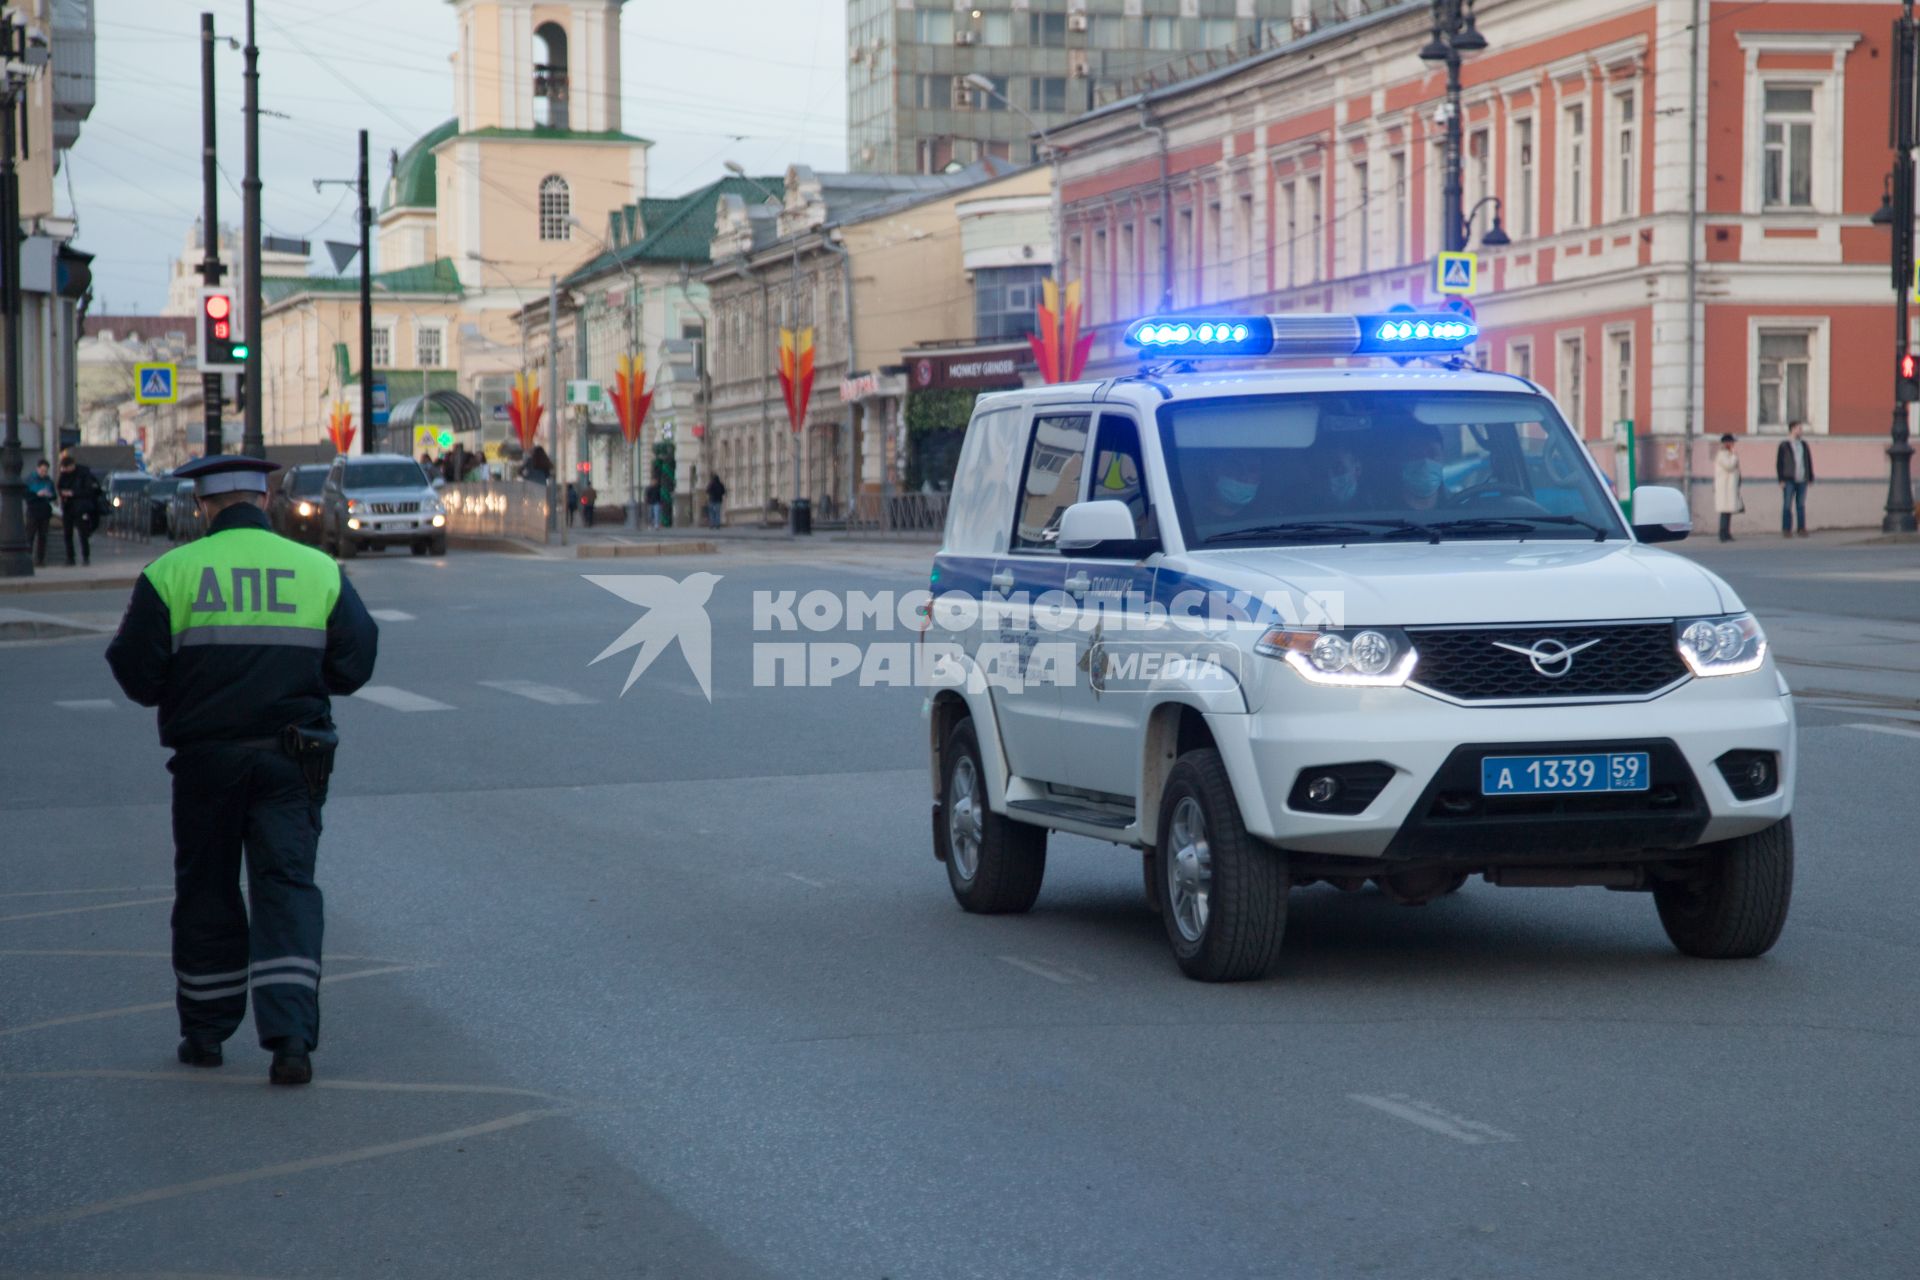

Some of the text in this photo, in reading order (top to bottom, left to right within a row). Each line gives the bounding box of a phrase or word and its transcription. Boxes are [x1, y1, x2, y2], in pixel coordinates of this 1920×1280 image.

[949, 360, 1014, 378] MONKEY GRINDER
[191, 566, 297, 614] ДПС
[1497, 756, 1640, 789] А 1339 59
[1615, 779, 1636, 787] RUS
